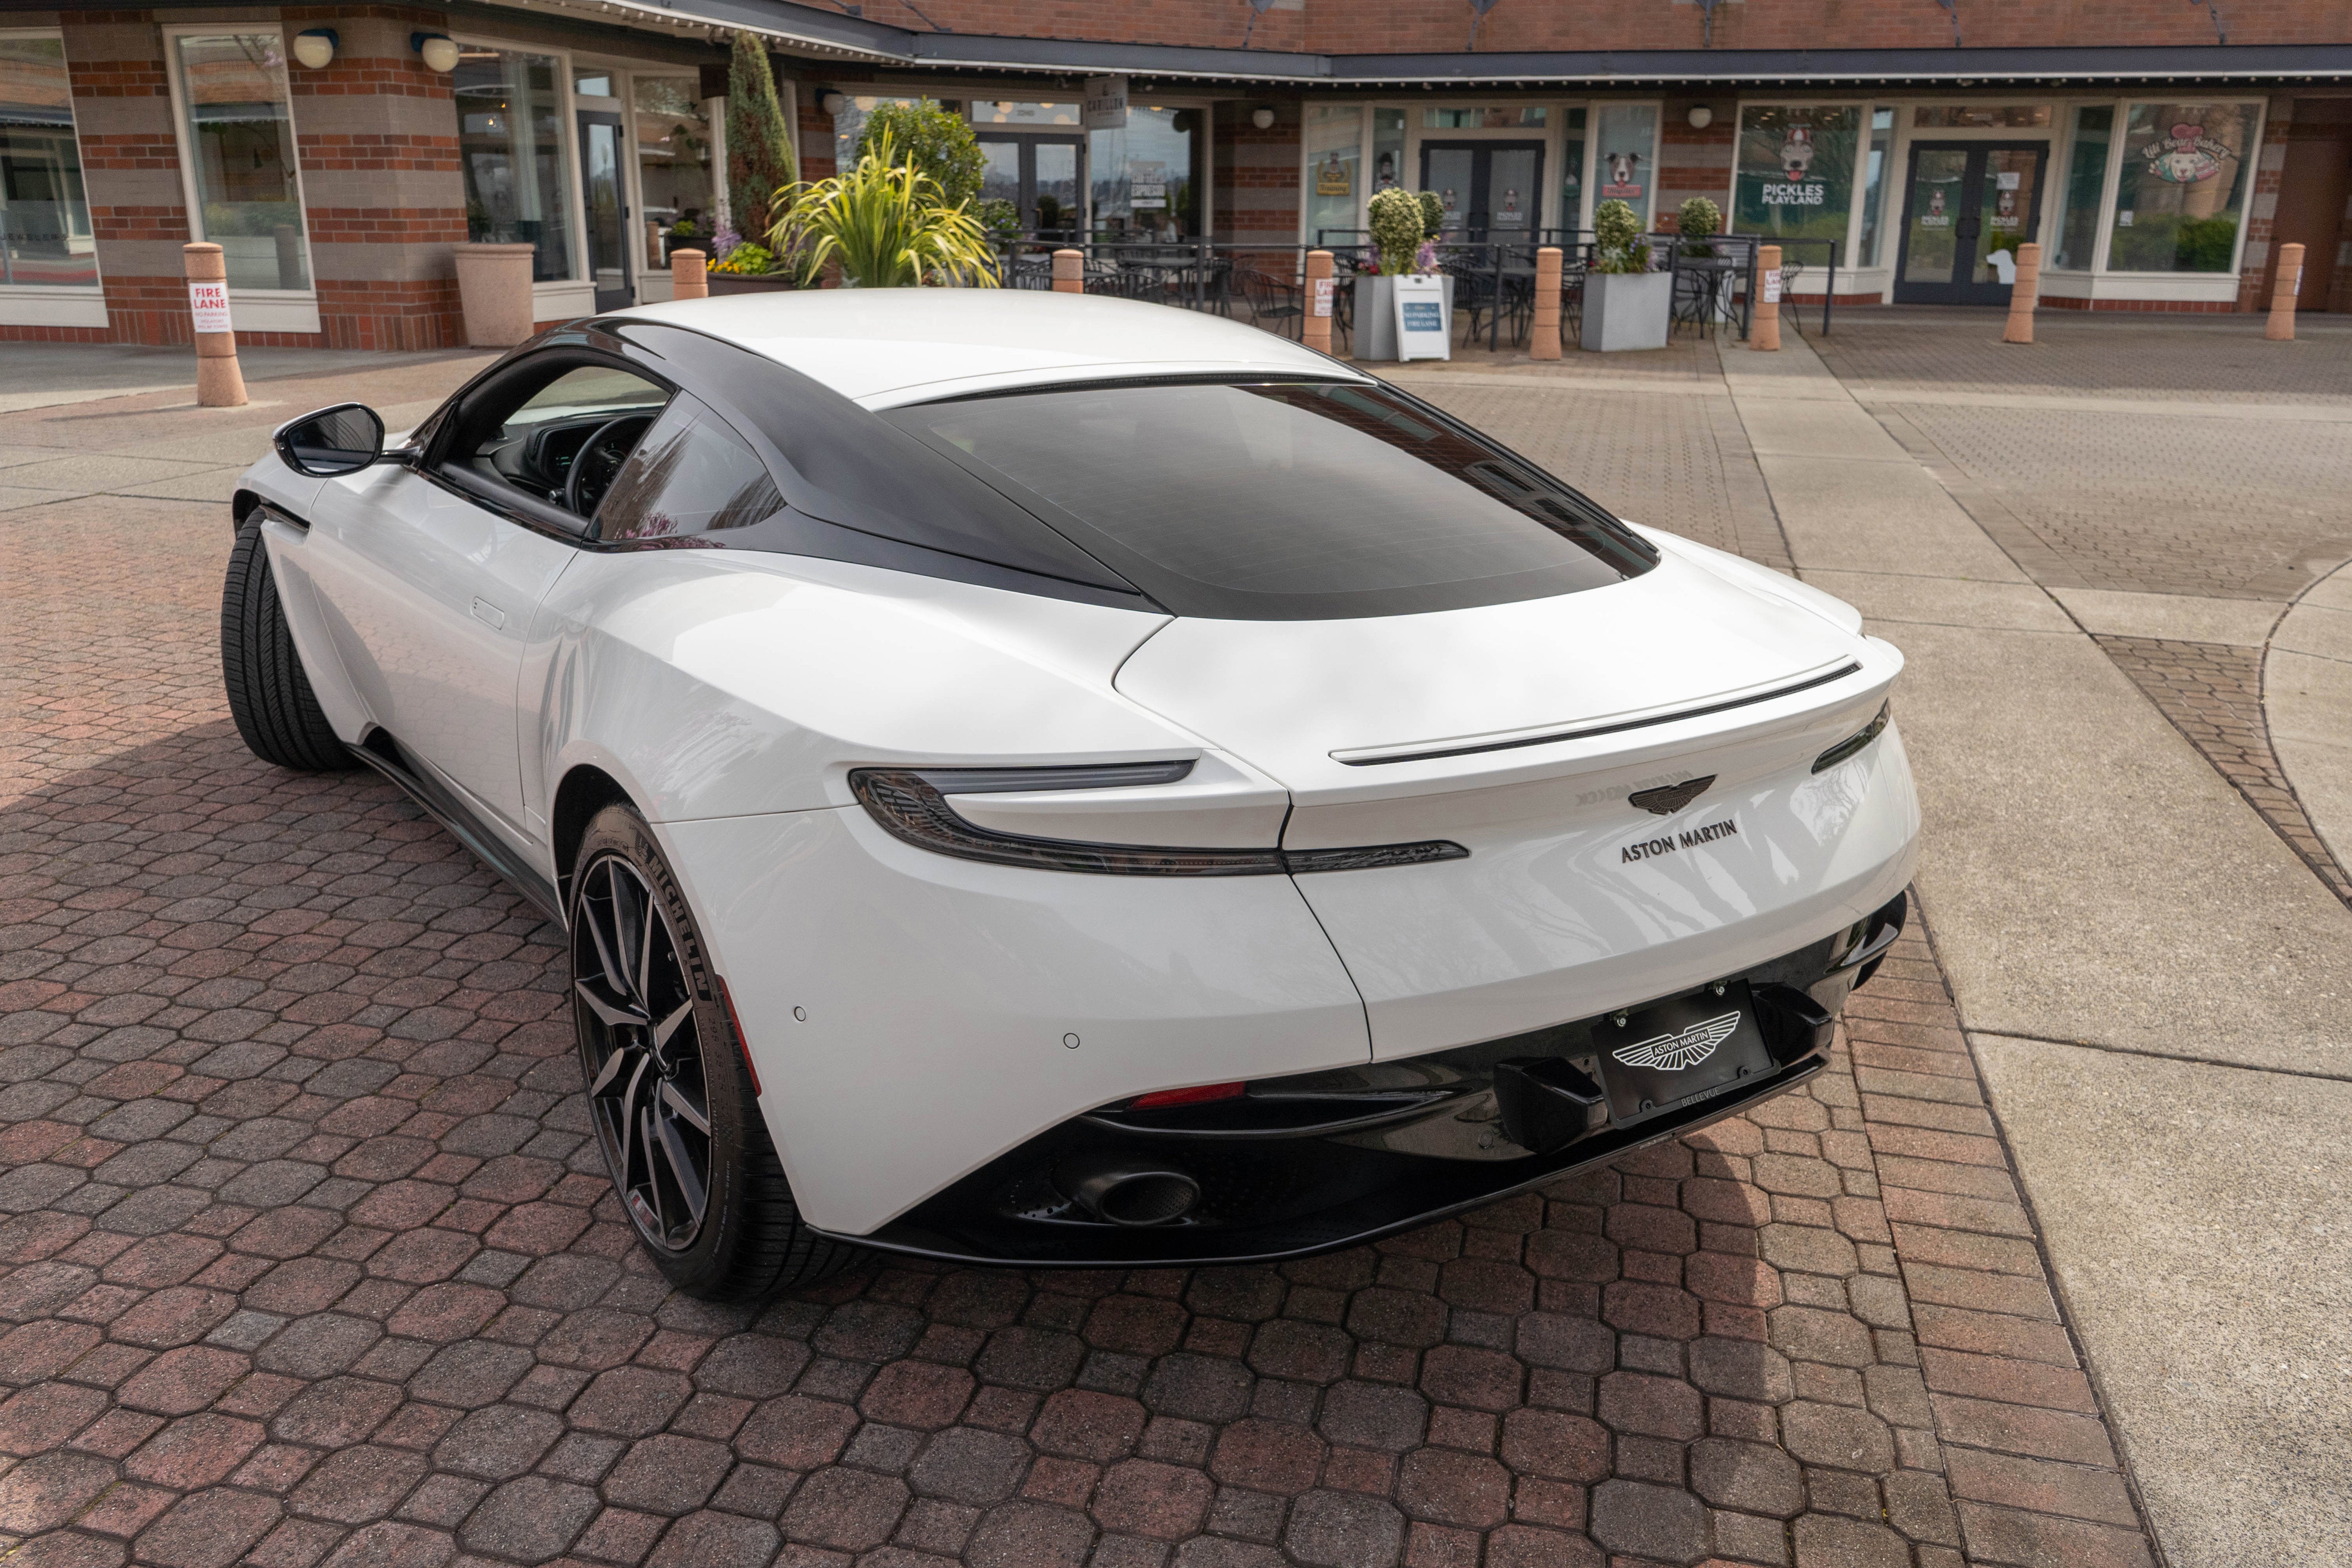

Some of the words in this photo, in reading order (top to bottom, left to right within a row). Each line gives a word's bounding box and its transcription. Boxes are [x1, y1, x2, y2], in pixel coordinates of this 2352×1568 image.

[1763, 184, 1824, 196] PICKLES
[1762, 195, 1823, 205] PLAYLAND
[195, 288, 220, 297] FIRE
[194, 299, 225, 309] LANE
[1622, 836, 1676, 864] ASTON
[1679, 819, 1737, 849] MARTIN
[648, 855, 708, 991] MICHELIN
[1654, 1041, 1679, 1056] ASTON
[1680, 1031, 1708, 1048] MARTIN
[1681, 1087, 1719, 1107] BELLEVUE
